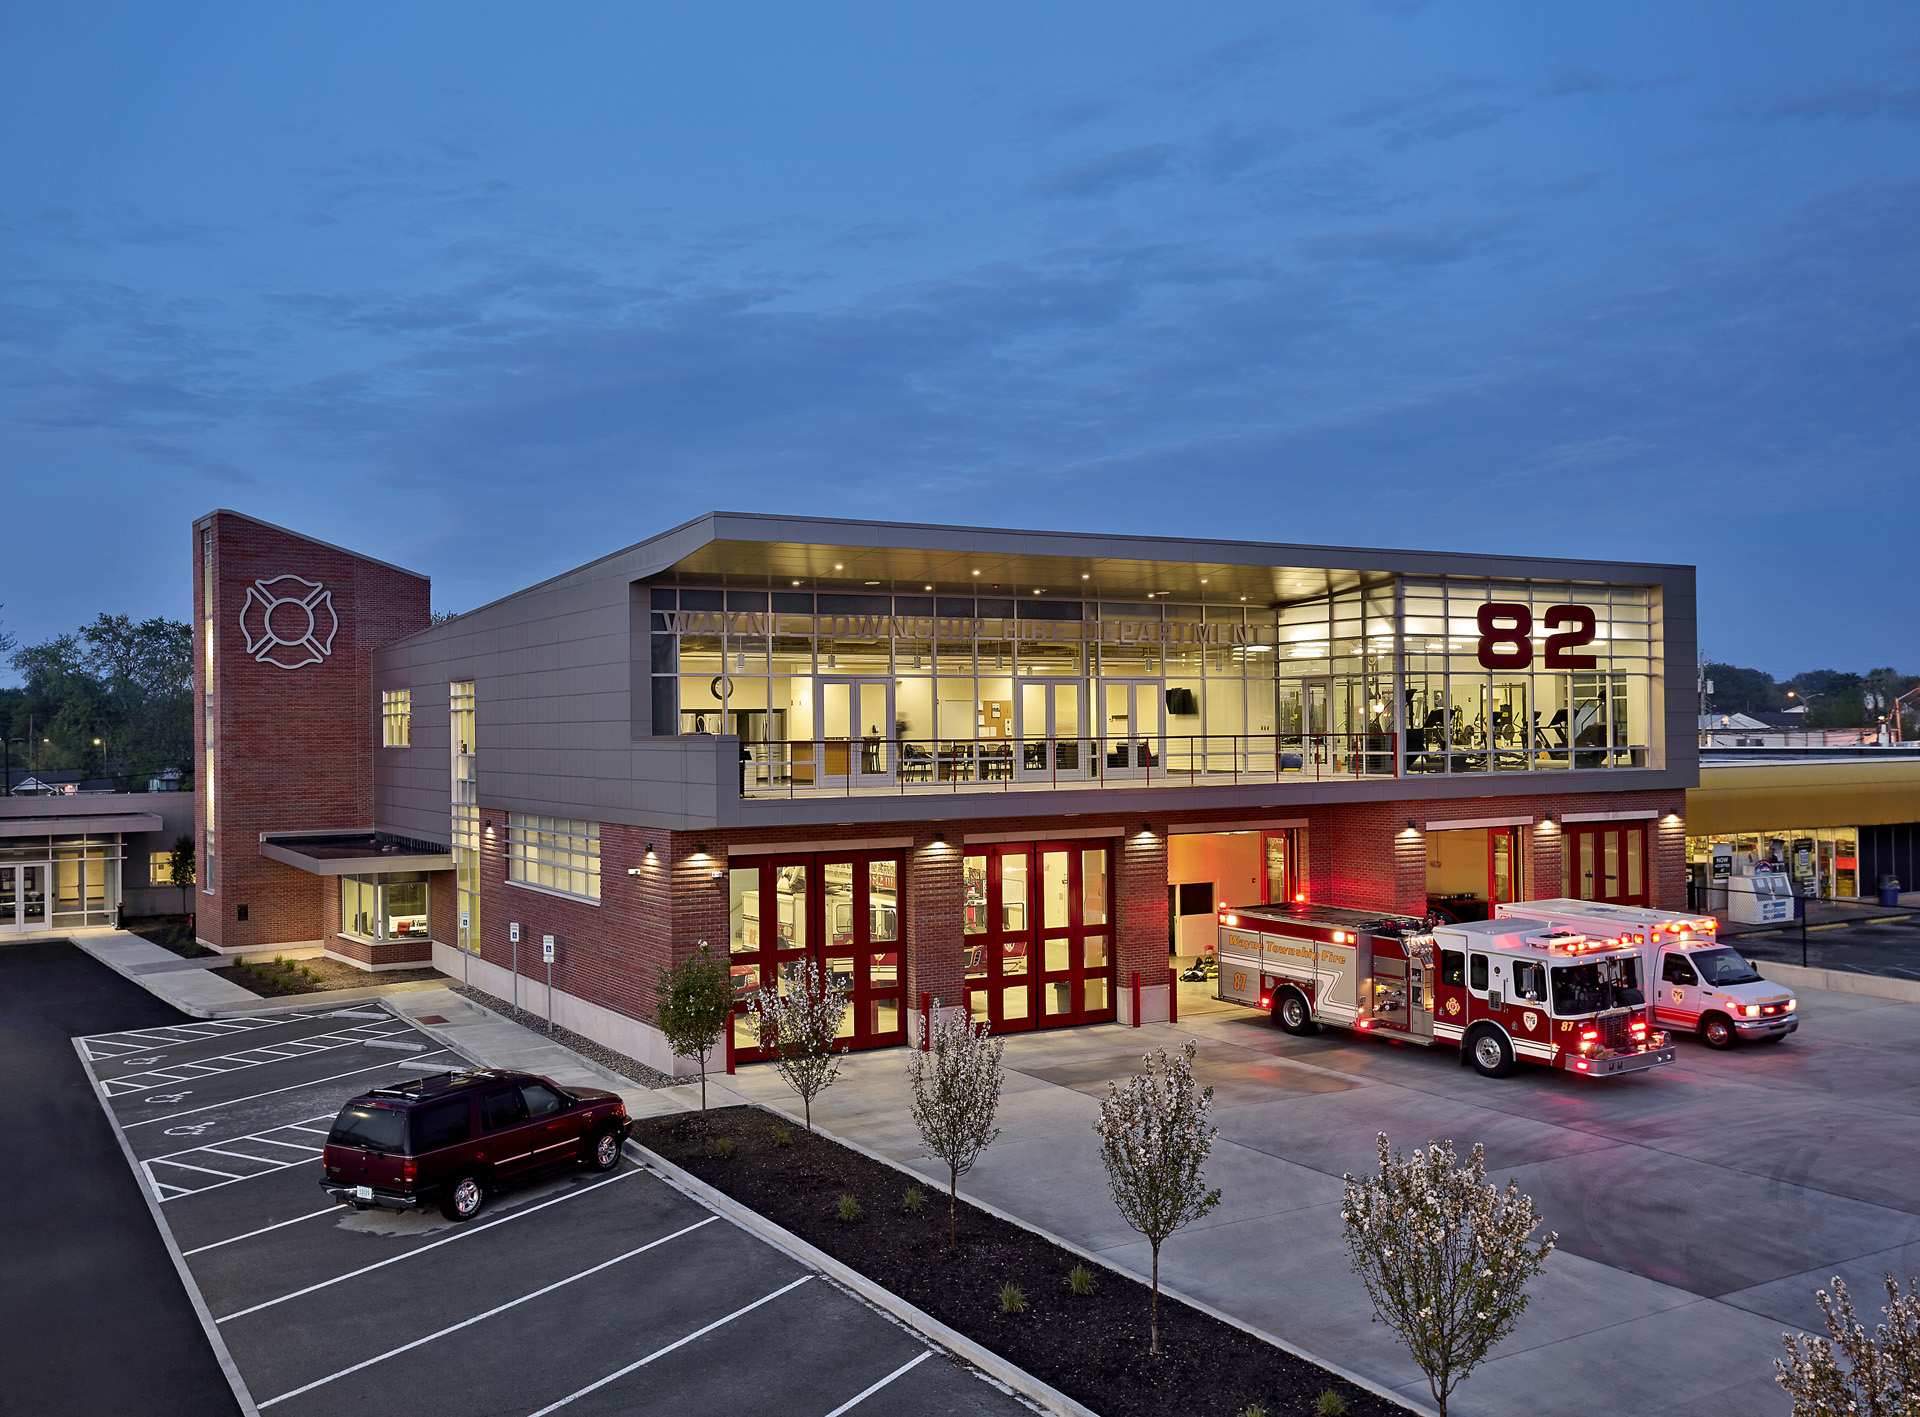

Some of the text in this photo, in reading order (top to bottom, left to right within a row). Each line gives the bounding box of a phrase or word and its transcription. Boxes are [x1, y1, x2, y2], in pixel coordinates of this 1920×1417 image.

[662, 610, 1267, 644] WAYNE TOWNSHIP FIRE DEPARTMENT
[1477, 603, 1597, 669] 82
[1229, 934, 1346, 964] Wayne Township Fire
[1233, 972, 1247, 991] 87
[1561, 1021, 1574, 1031] 87
